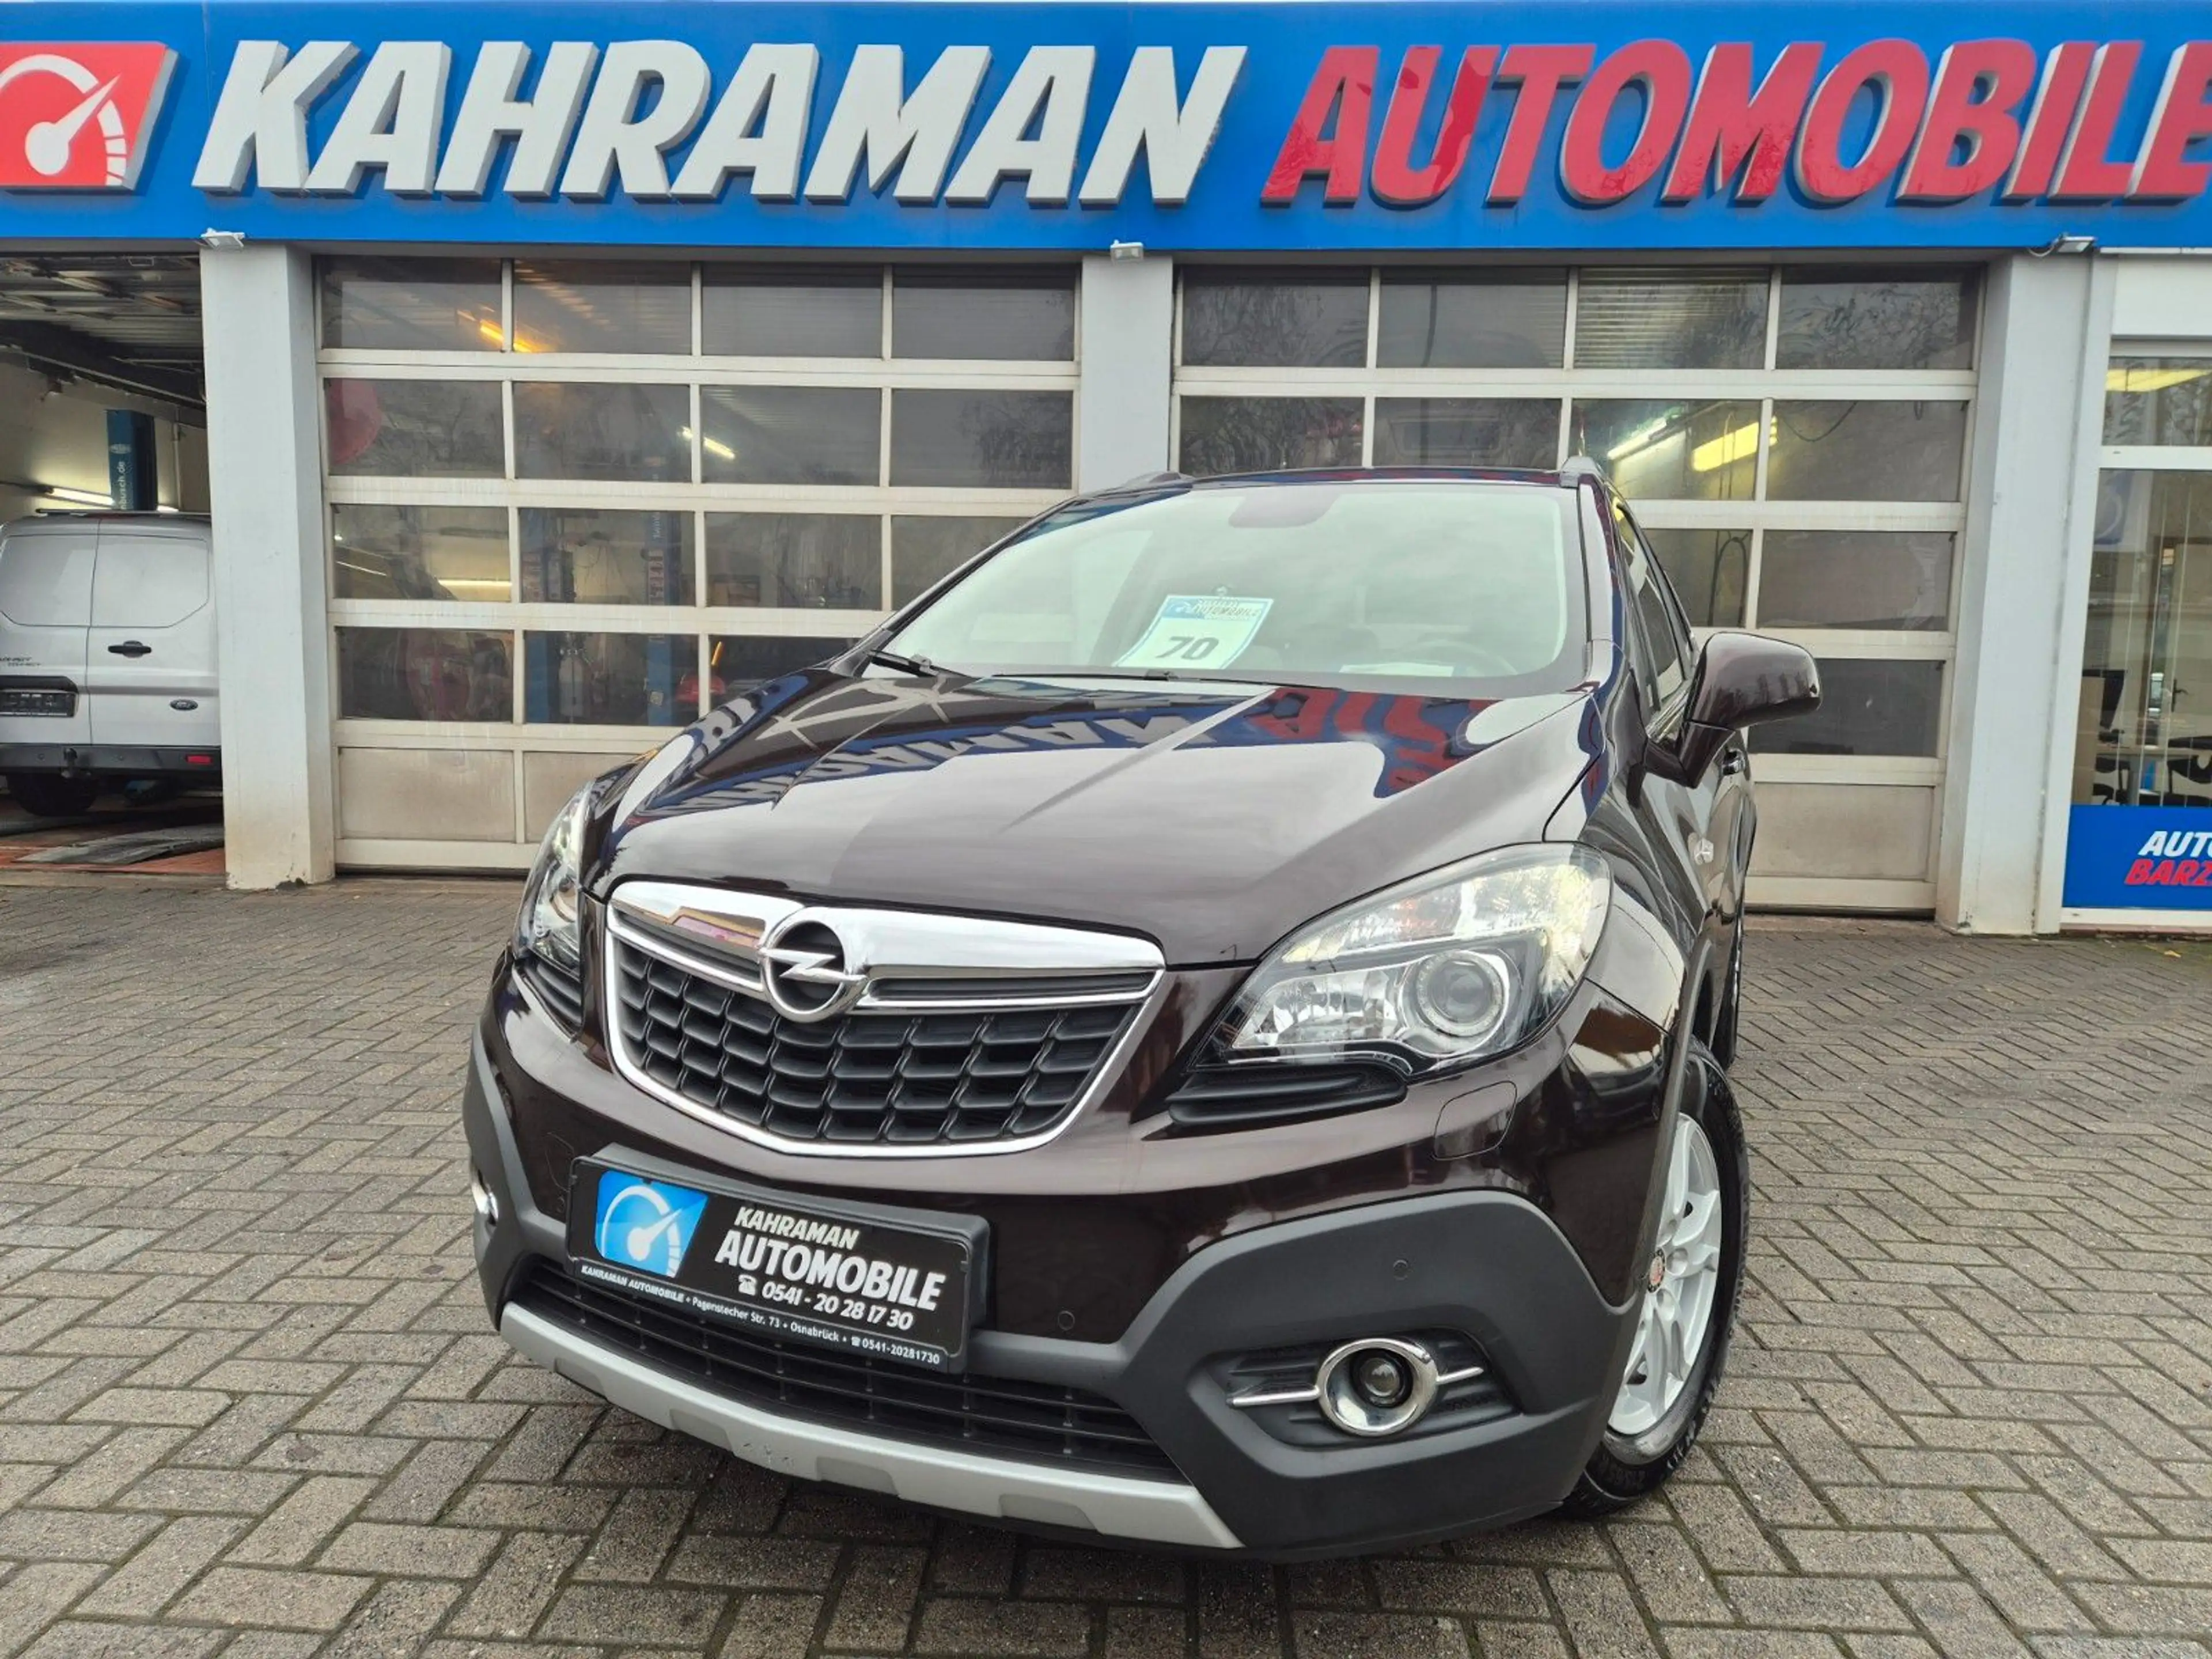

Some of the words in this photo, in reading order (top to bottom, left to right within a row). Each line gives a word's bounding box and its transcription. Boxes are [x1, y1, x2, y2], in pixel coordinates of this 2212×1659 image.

[191, 38, 1248, 203] KAHRAMAN
[1260, 37, 2212, 205] AUTOMOBILE
[1155, 636, 1219, 660] 70
[2138, 831, 2212, 858] AUT
[734, 1207, 859, 1250] KAHRAMAN
[714, 1229, 946, 1310] AUTOMOBILE
[581, 1264, 628, 1287] KAHRAMAN
[628, 1278, 685, 1304] AUTOMOBILE
[692, 1296, 748, 1320] Pagenstecher
[751, 1310, 766, 1325] Str.
[768, 1316, 780, 1328] 73
[790, 1321, 839, 1342] Osnabrück
[862, 1337, 941, 1365] 0541-20281730
[762, 1281, 803, 1306] 0541
[813, 1293, 839, 1314] 20
[840, 1299, 865, 1320] 28
[866, 1305, 888, 1324] 17
[887, 1309, 914, 1331] 30
